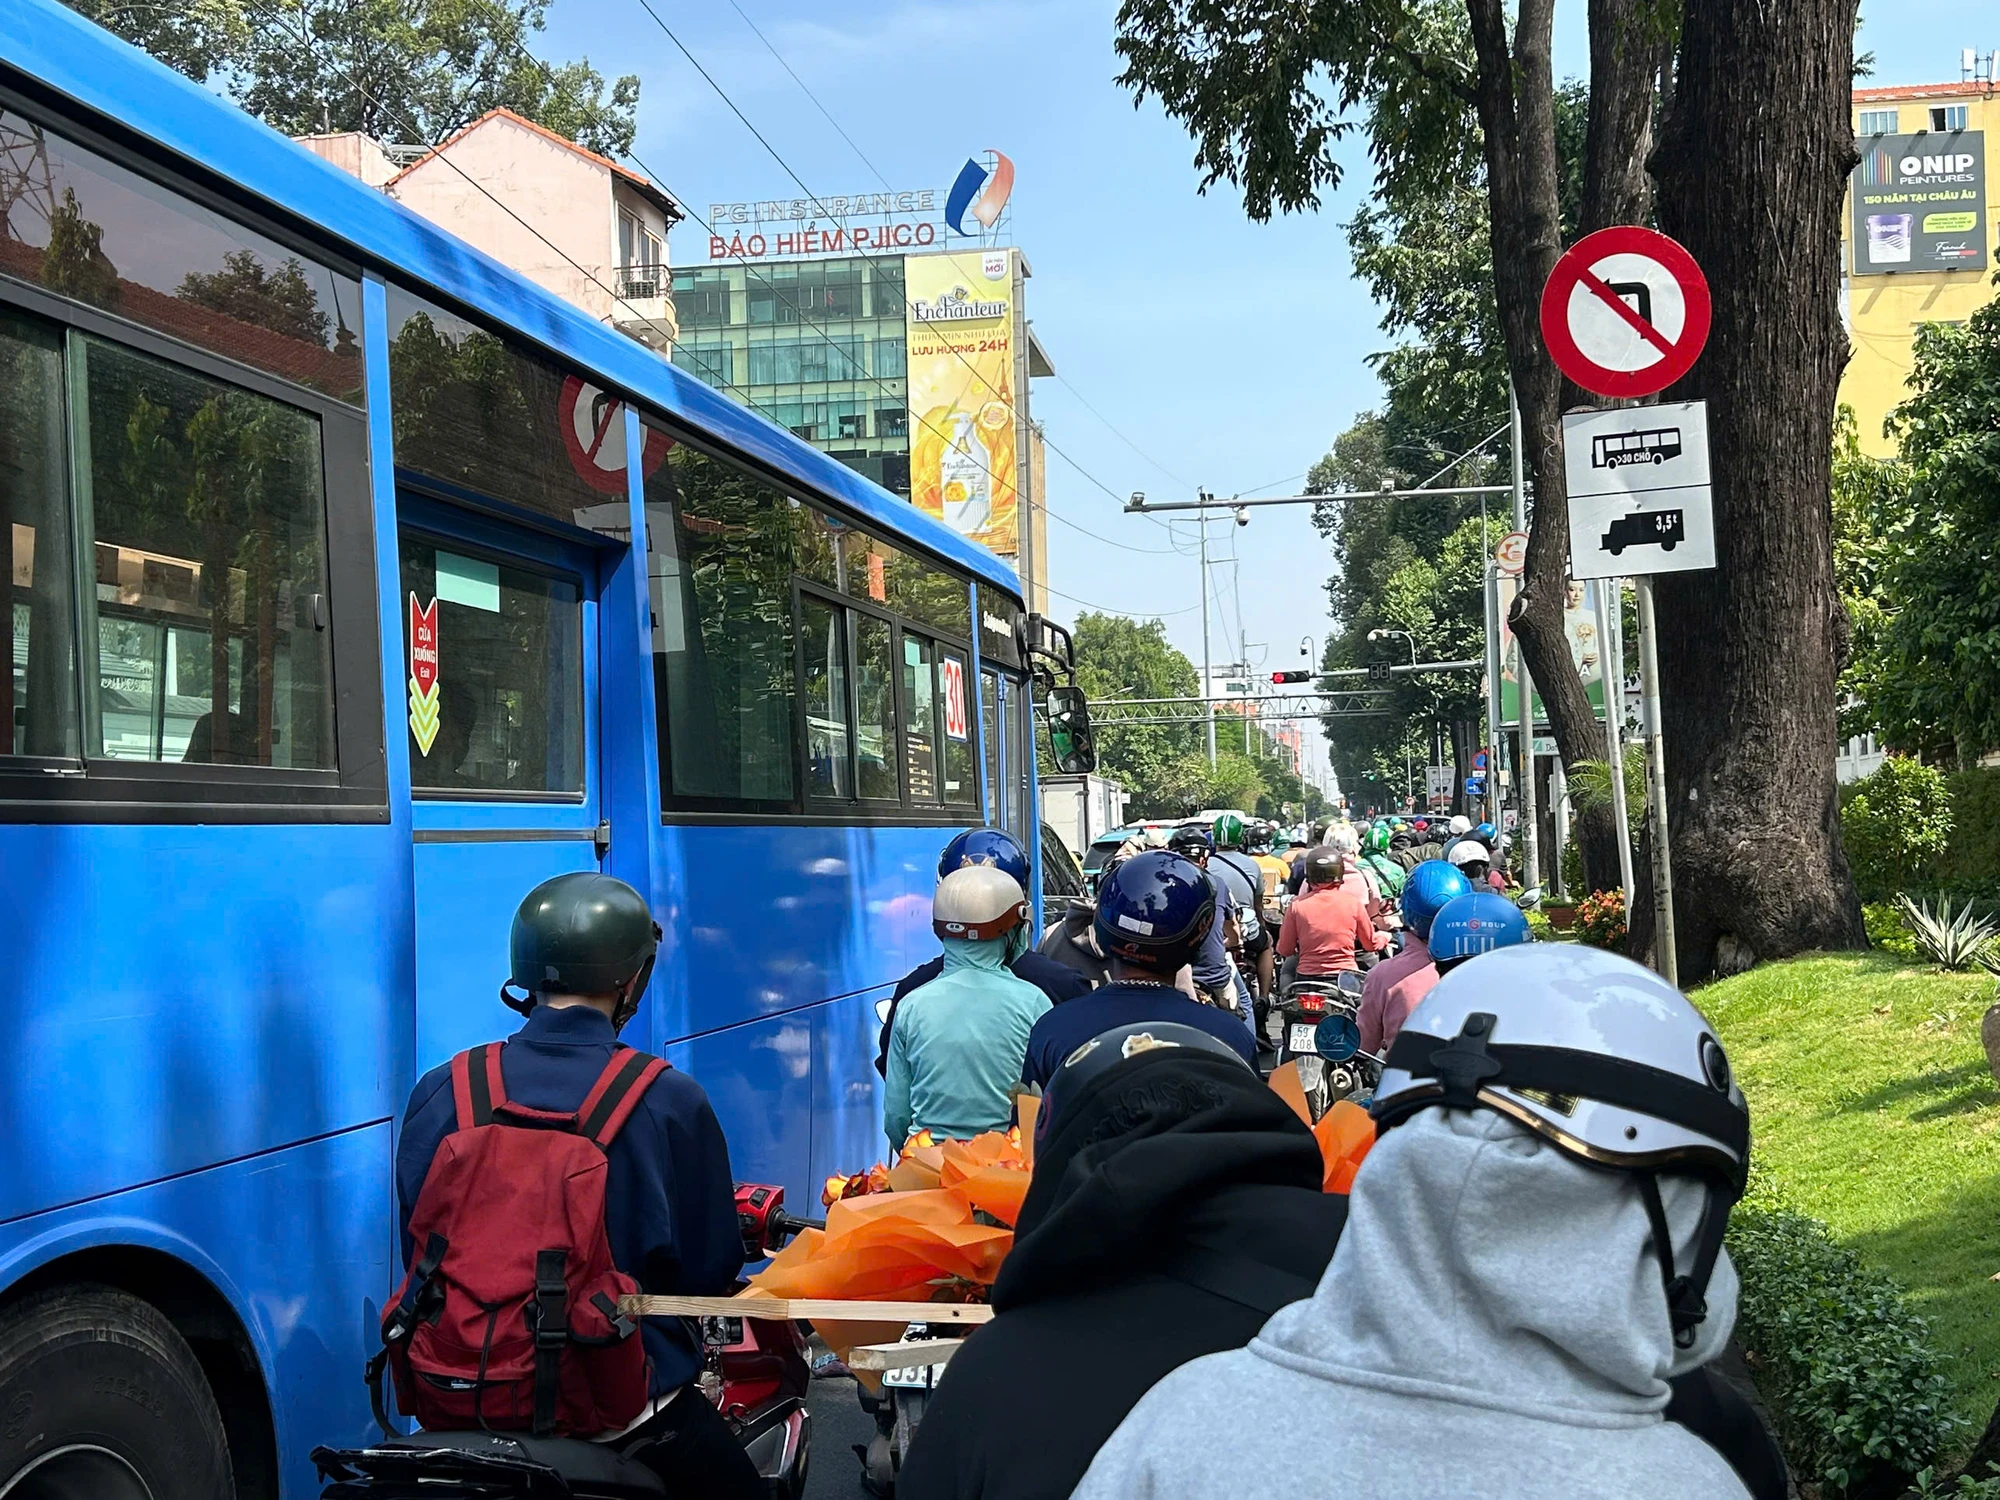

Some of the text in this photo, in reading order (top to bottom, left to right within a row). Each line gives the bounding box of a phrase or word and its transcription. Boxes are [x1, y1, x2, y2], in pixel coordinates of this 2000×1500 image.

[1899, 153, 1975, 176] ONIP
[1900, 173, 1975, 185] PEINTURES
[710, 190, 935, 224] PG INSURANCE
[1863, 189, 1977, 205] 150 NĂM TẠI CHÂU ÂU
[710, 221, 935, 259] BẢO HIỂM PJICO
[914, 296, 1008, 321] Enchanteur
[978, 338, 1008, 353] 24H
[945, 662, 964, 736] 30
[1297, 1026, 1309, 1038] 59
